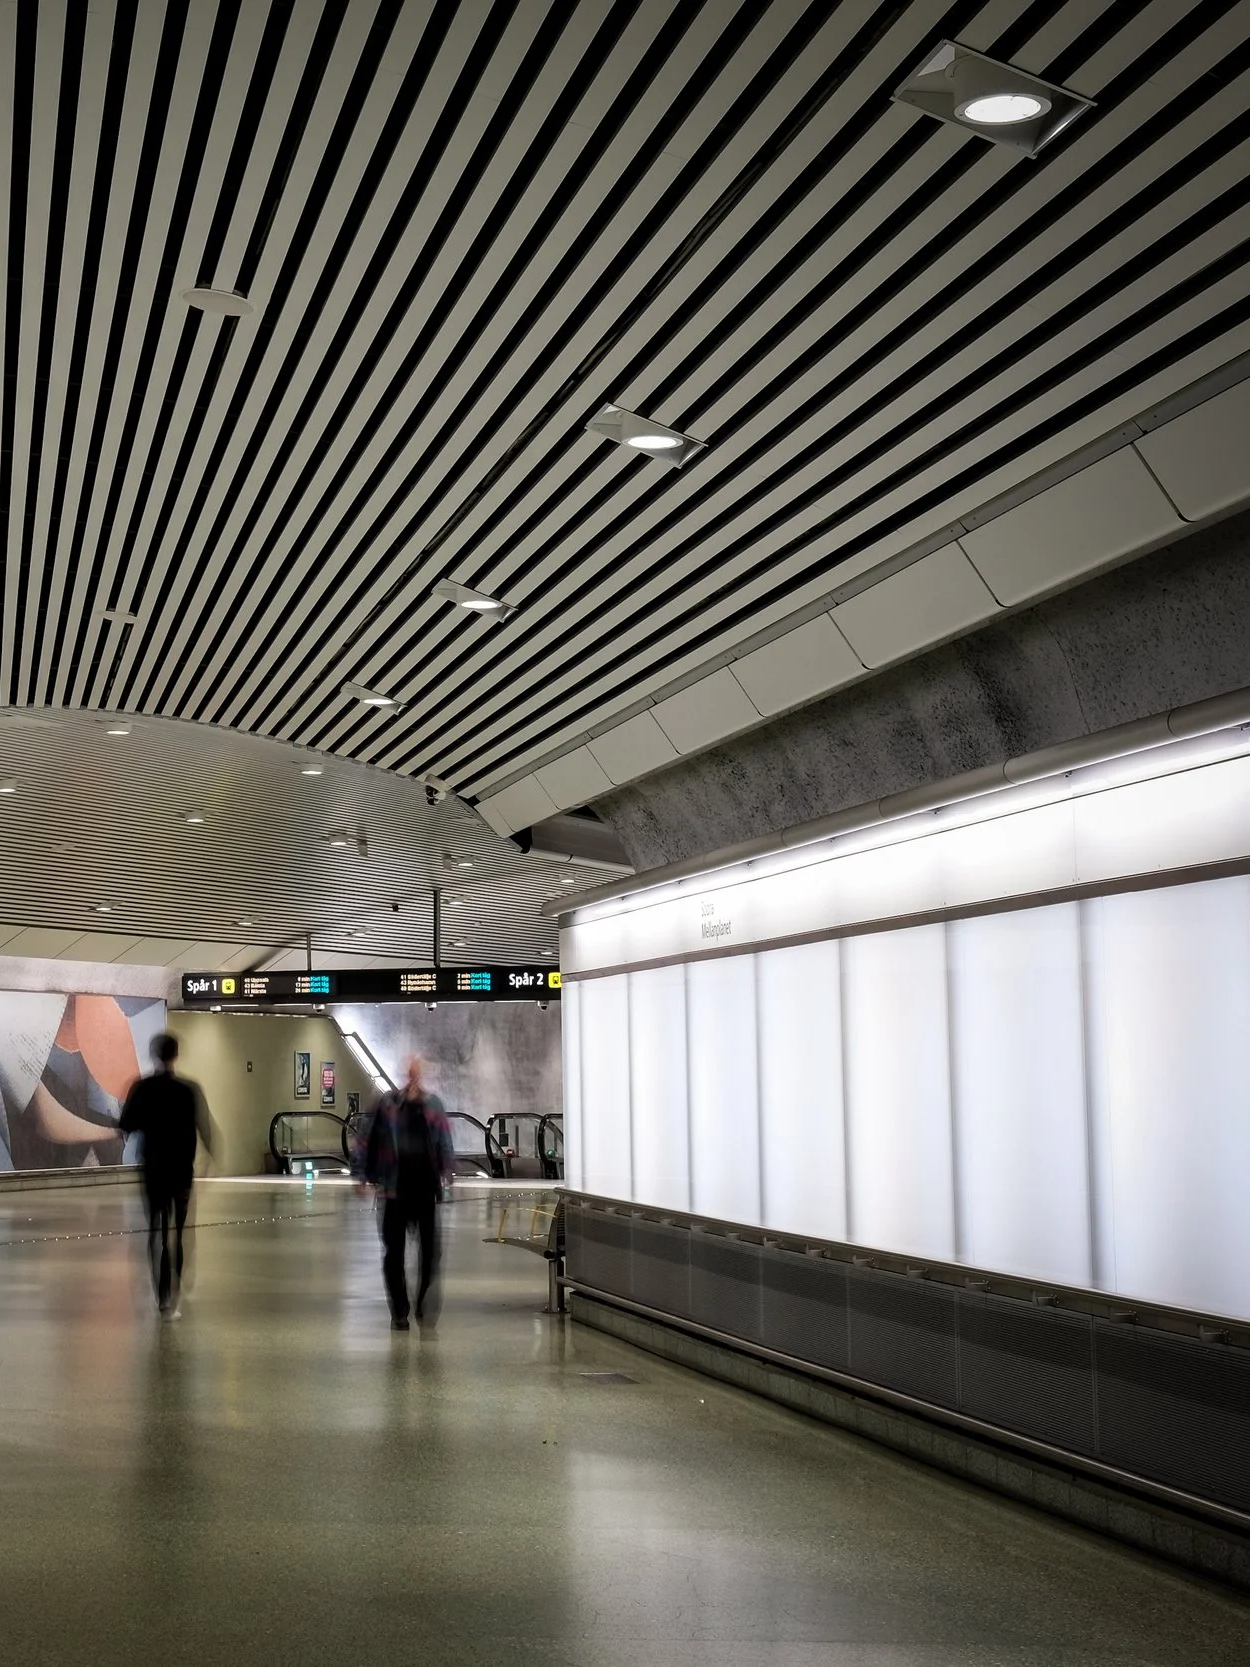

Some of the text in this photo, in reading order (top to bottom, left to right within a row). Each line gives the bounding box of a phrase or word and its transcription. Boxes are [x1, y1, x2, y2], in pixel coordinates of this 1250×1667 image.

[701, 919, 732, 941] Mellanplanet
[187, 979, 217, 994] Spår 1
[509, 972, 544, 988] Spår 2
